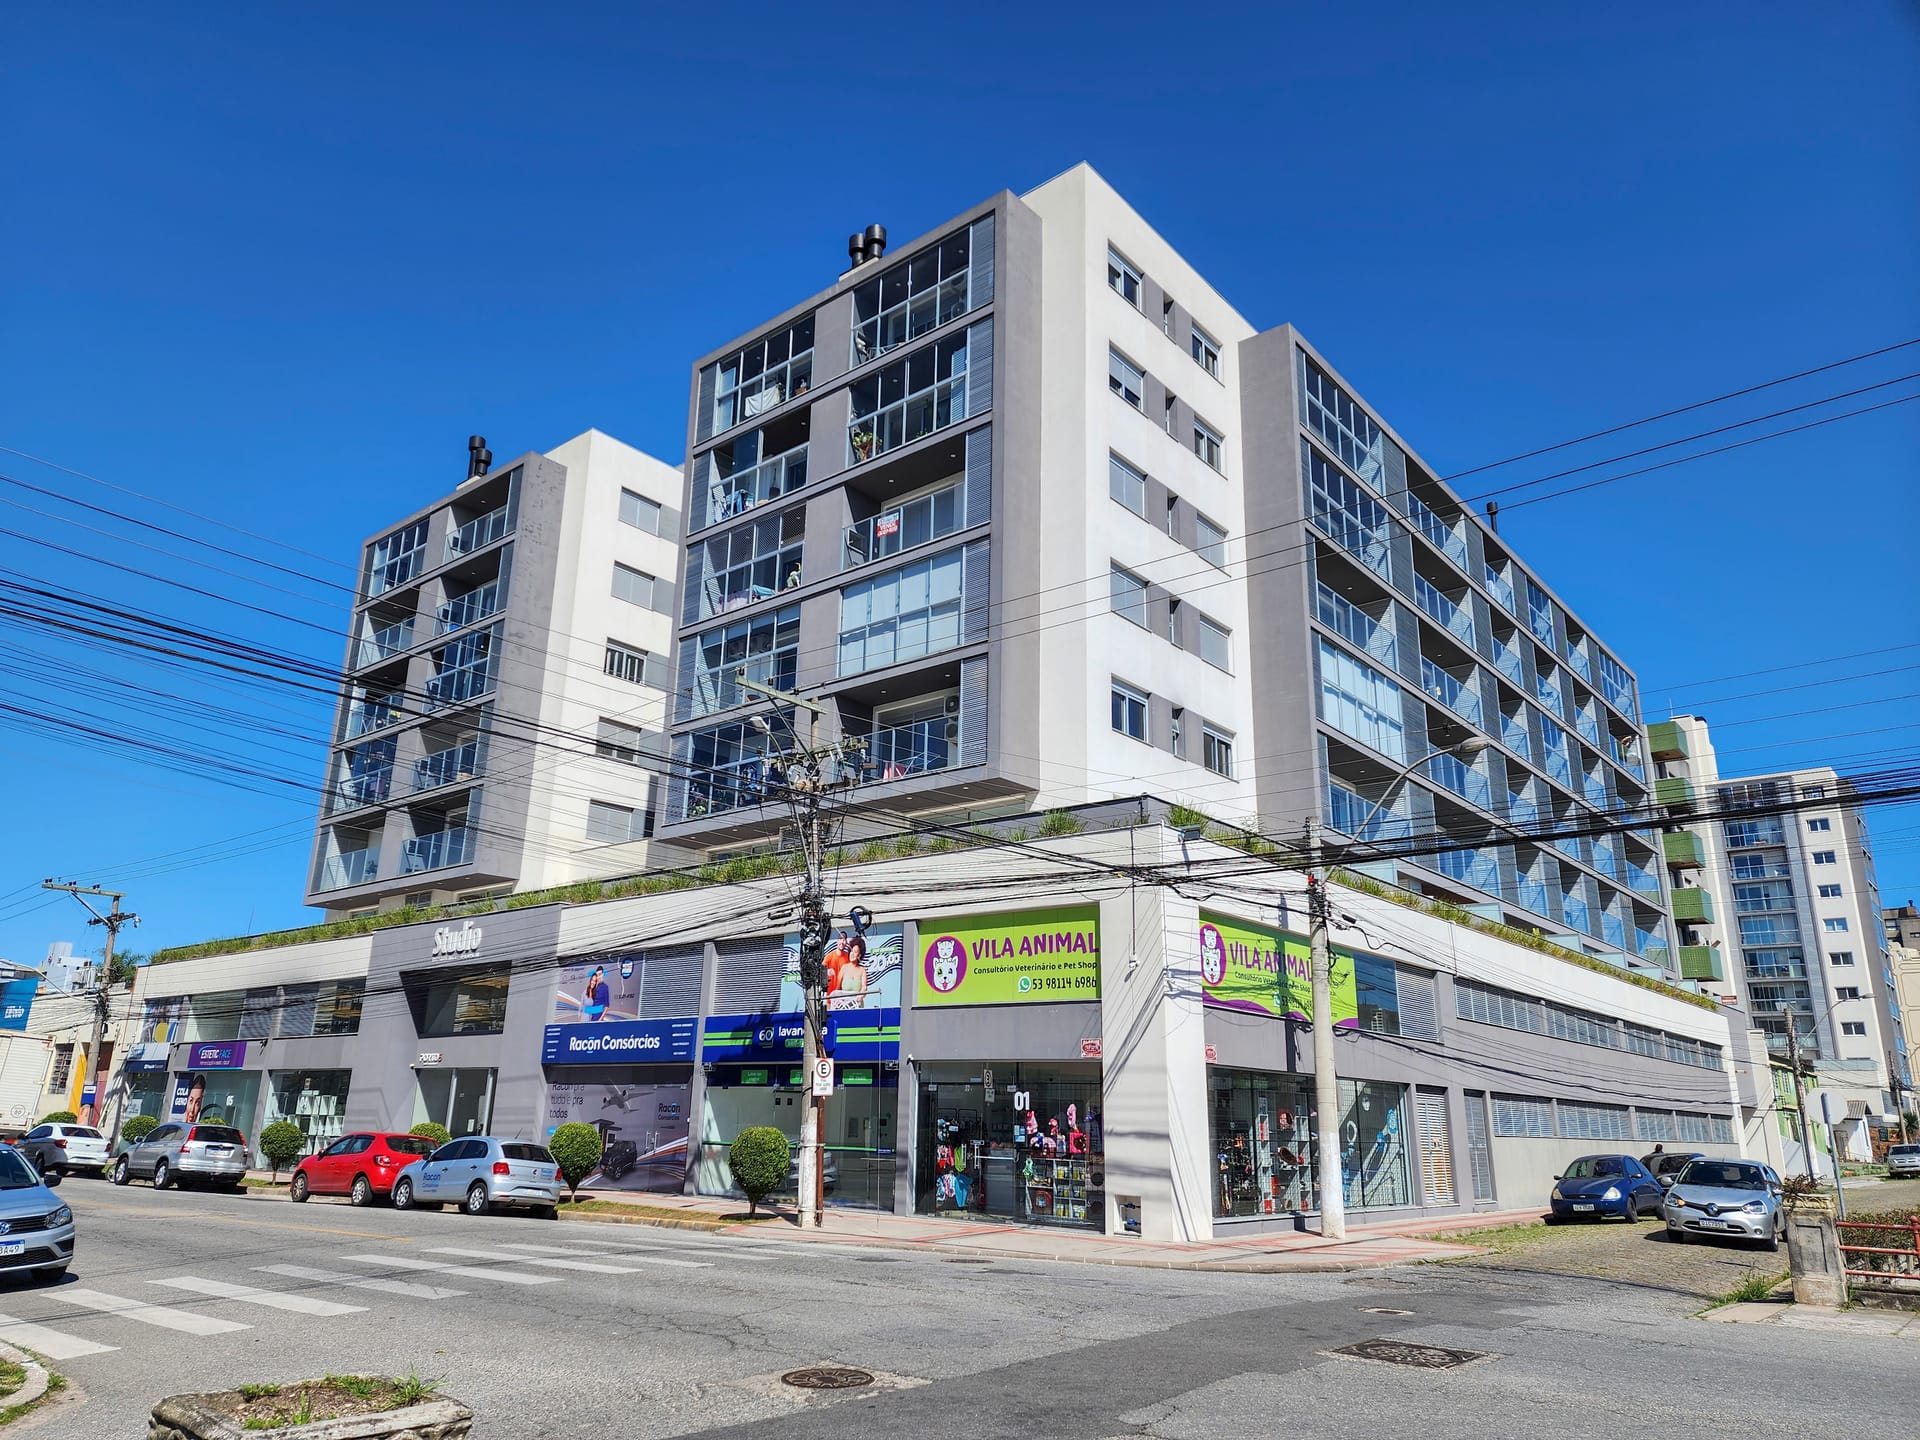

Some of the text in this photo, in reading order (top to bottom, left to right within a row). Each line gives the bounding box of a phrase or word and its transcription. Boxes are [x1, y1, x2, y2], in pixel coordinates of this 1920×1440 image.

[432, 921, 482, 954] Studio
[972, 932, 1099, 960] VILA ANIMAL
[973, 964, 1014, 974] Consultório
[1015, 961, 1056, 971] Veterinário
[1077, 961, 1098, 970] Shop
[1229, 941, 1312, 982] VILA ANIMAL
[1032, 976, 1097, 989] 53 98114 6986
[759, 1029, 773, 1041] 60
[570, 1036, 600, 1053] Racon
[601, 1034, 660, 1050] Consórcios
[177, 1088, 189, 1096] COLA
[572, 1097, 584, 1106] pra
[1014, 1091, 1030, 1111] 01
[549, 1108, 568, 1119] todos
[658, 1103, 680, 1113] Racon
